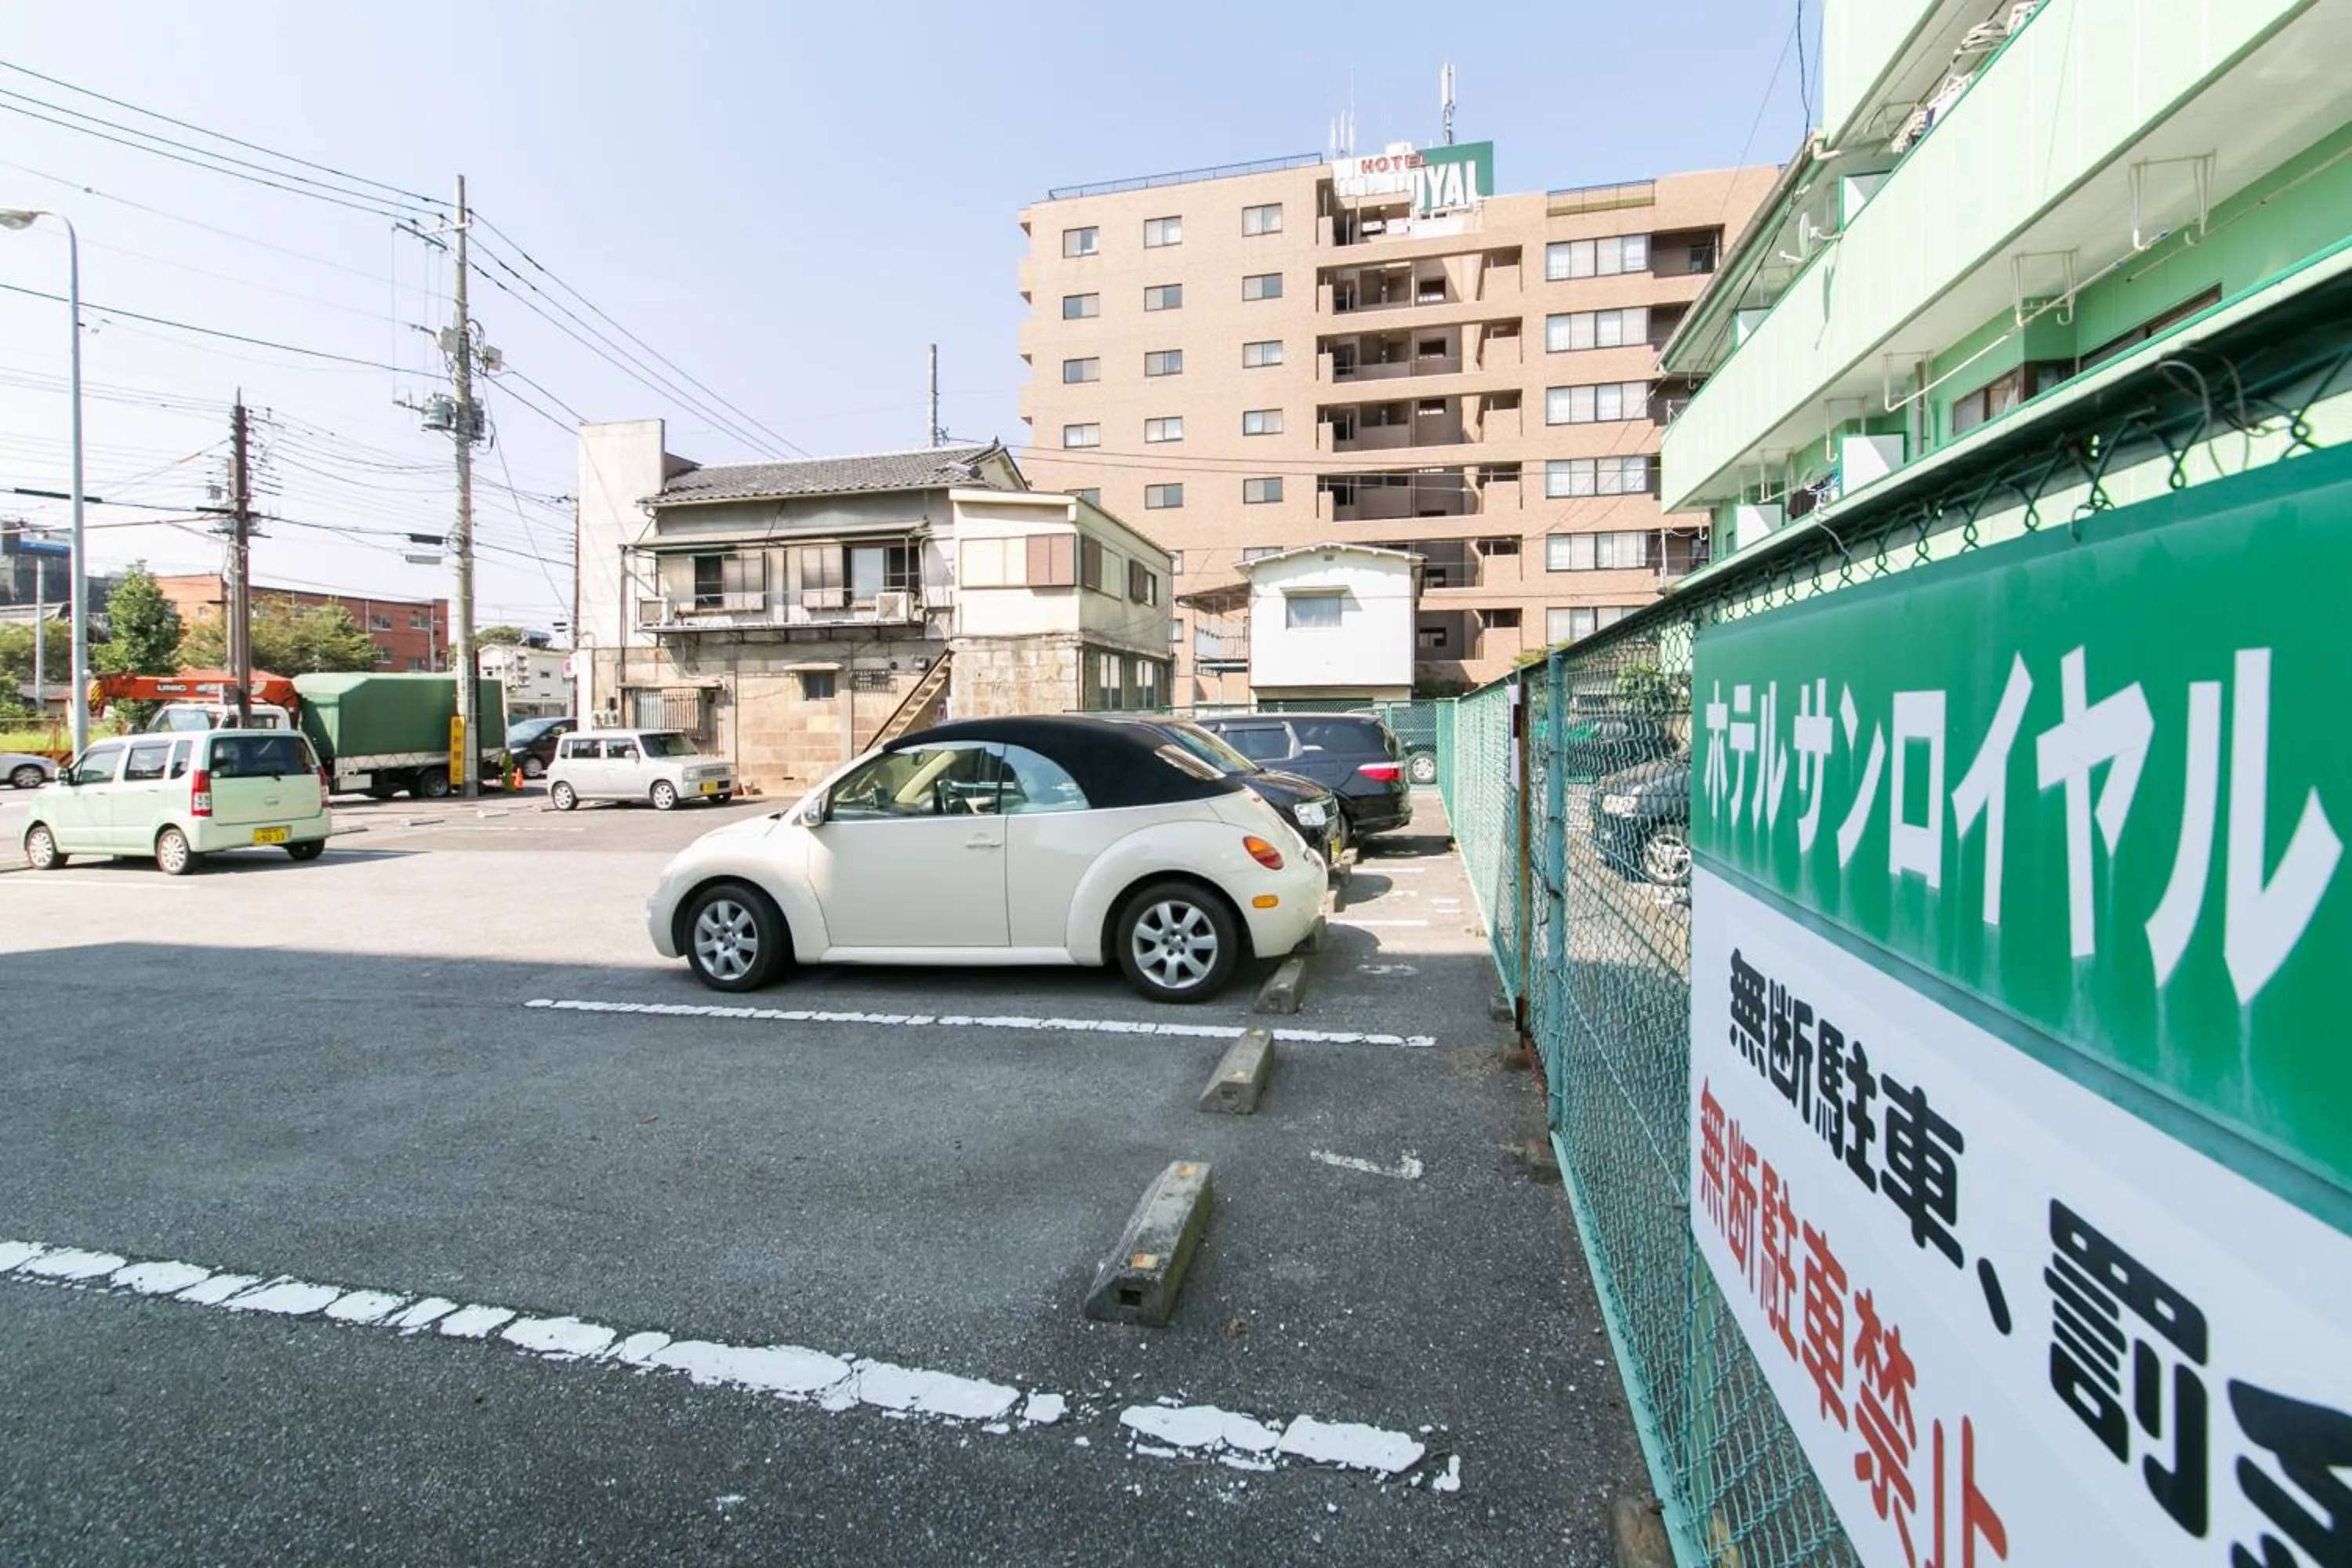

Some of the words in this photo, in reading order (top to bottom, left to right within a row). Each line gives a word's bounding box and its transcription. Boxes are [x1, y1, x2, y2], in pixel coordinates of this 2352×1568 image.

[1361, 152, 1429, 173] HOTEL
[1704, 645, 2344, 1006] ホテルサンロイヤル
